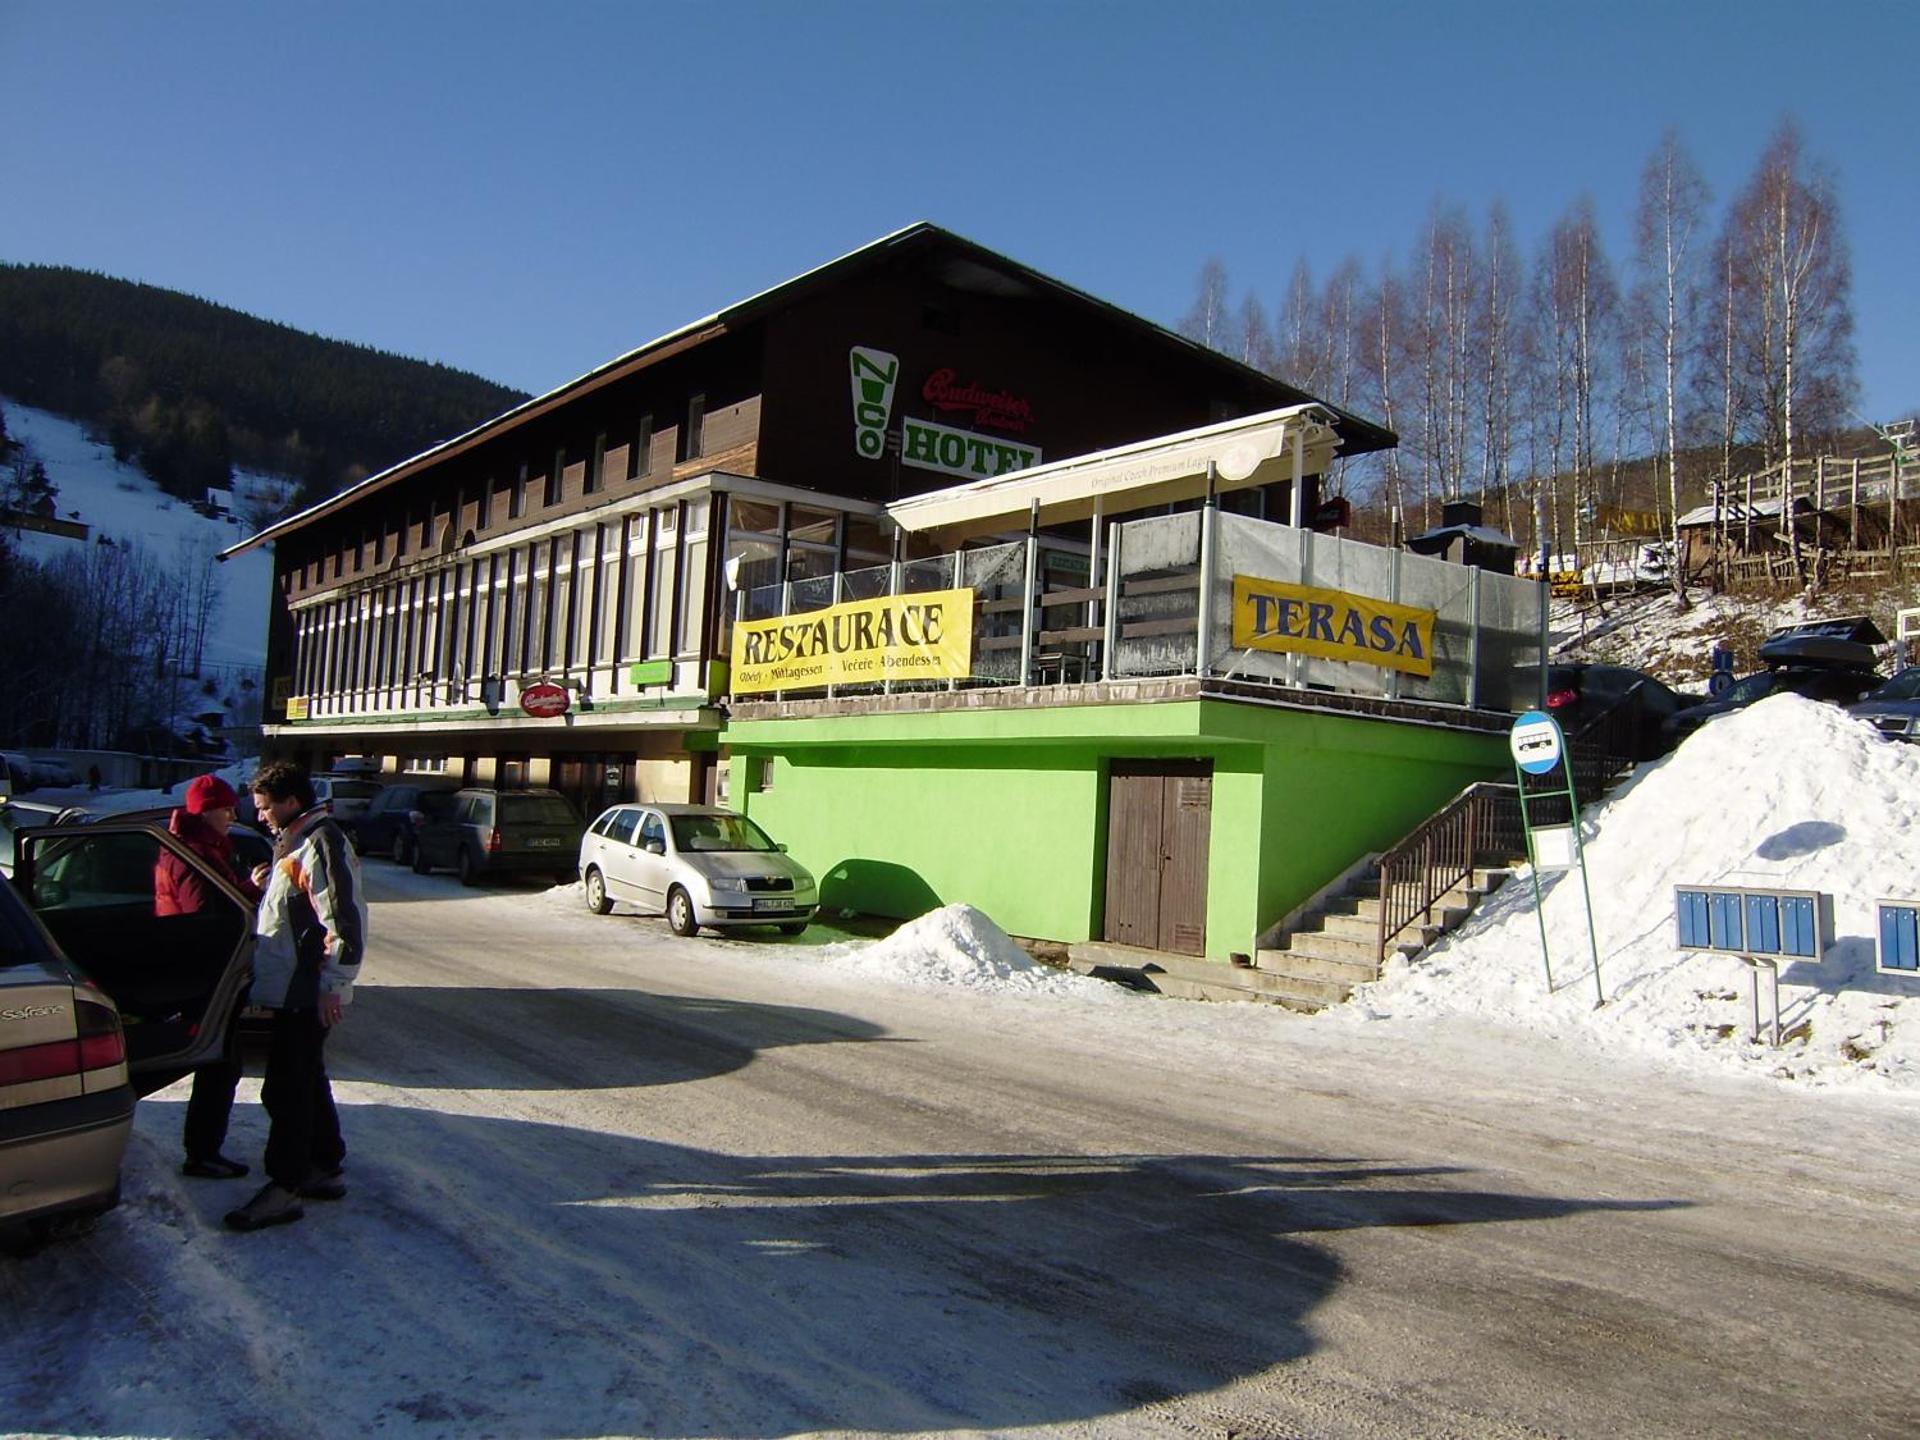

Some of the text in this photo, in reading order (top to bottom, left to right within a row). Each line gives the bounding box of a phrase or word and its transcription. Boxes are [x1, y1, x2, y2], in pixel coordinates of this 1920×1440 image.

[852, 351, 897, 455] NICO
[743, 604, 944, 665] RESTAURACE
[1247, 593, 1425, 659] TERASA
